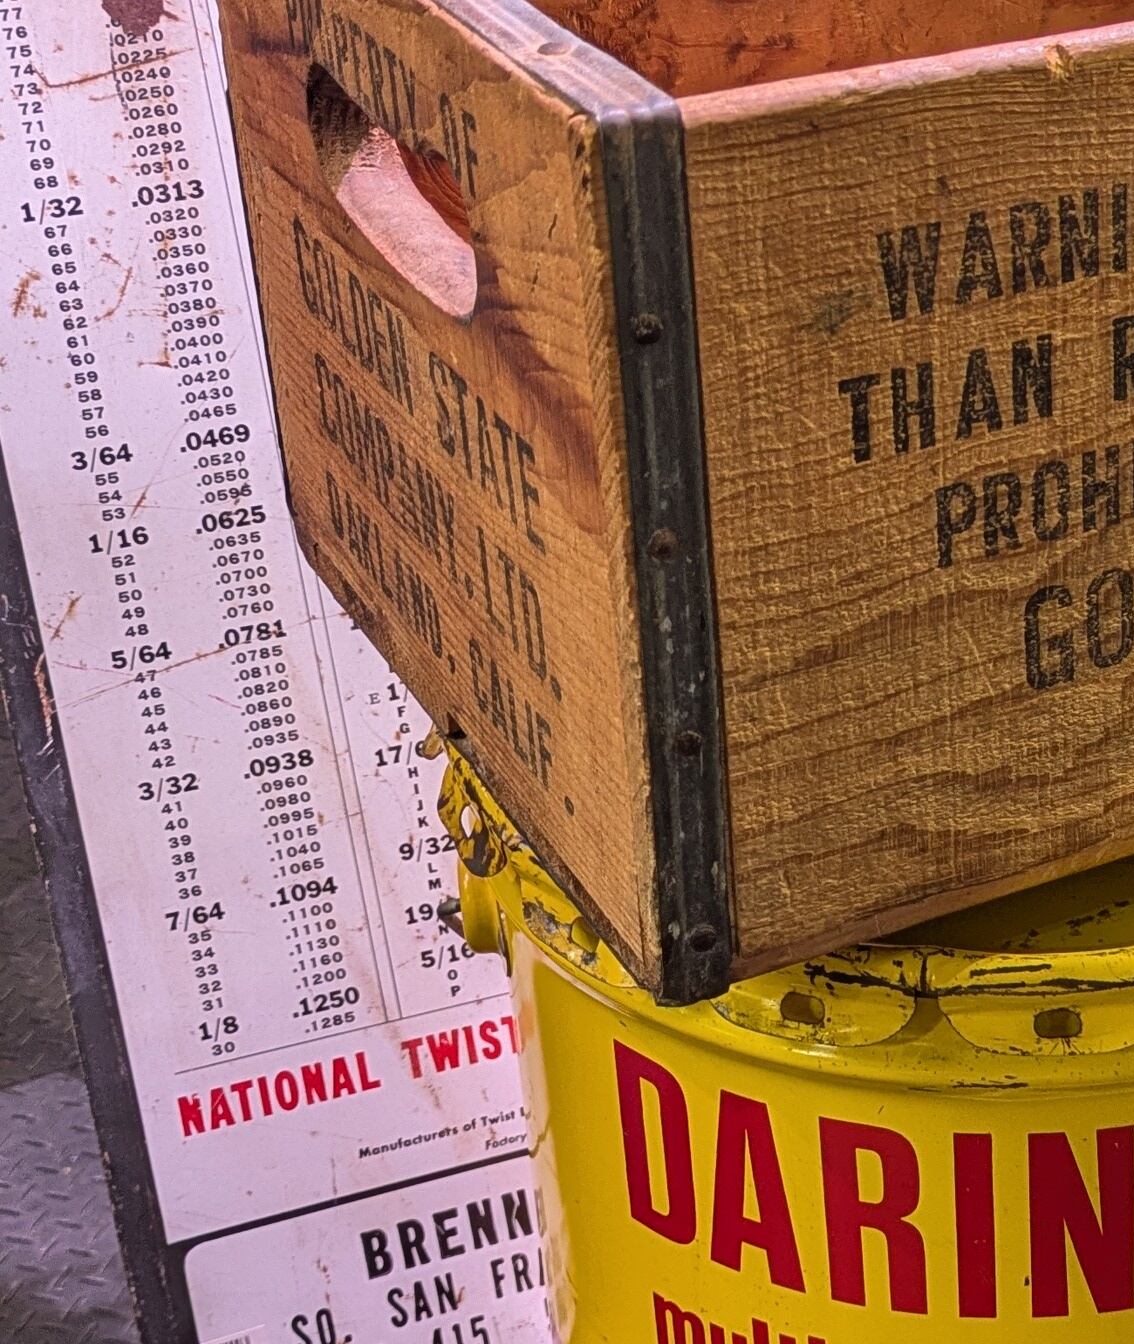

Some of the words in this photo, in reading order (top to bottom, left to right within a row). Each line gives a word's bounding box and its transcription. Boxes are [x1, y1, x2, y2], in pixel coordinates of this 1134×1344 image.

[2, 26, 27, 40] 76
[10, 64, 36, 78] 74
[18, 101, 43, 115] 72
[122, 85, 174, 102] .0250
[26, 139, 51, 152] 70
[128, 122, 181, 139] .0280
[439, 91, 478, 198] OF
[34, 175, 58, 189] 68
[136, 158, 189, 176] .0310
[21, 196, 83, 224] 1/32
[132, 180, 204, 206] .0313
[48, 243, 72, 257] 66
[149, 225, 202, 243] .0330
[56, 280, 80, 294] 64
[156, 261, 209, 279] .0360
[63, 317, 87, 330] 62
[71, 353, 95, 367] 60
[170, 333, 223, 351] .0400
[79, 389, 102, 403] 58
[177, 368, 230, 387] .0420
[294, 214, 414, 417] GOLDEN
[429, 351, 546, 555] STATE
[839, 333, 1054, 464] THAN
[85, 425, 109, 438] 56
[184, 403, 236, 422] .0465
[71, 444, 133, 472] 3/64
[180, 424, 251, 453] .0469
[99, 490, 122, 504] 54
[197, 468, 249, 486] .0550
[89, 526, 149, 554] 1/16
[196, 505, 266, 533] .0625
[112, 555, 135, 568] 52
[209, 531, 261, 550] .0635
[119, 589, 142, 603] 50
[215, 566, 267, 585] .0700
[125, 624, 149, 637] 48
[222, 600, 273, 619] .0760
[111, 642, 172, 670] 5/64
[218, 620, 287, 649] .0781
[138, 687, 161, 700] 46
[234, 663, 285, 681] .0810
[145, 722, 168, 734] 44
[241, 697, 292, 715] .0860
[397, 706, 406, 718] F
[399, 723, 411, 734] G
[152, 756, 175, 768] 42
[247, 730, 299, 749] .0935
[138, 773, 199, 801] 3/32
[244, 749, 314, 777] .0938
[408, 767, 419, 779] H
[165, 818, 188, 831] 40
[260, 792, 310, 811] .0980
[418, 816, 429, 828] K
[172, 852, 195, 865] 38
[267, 824, 317, 844] .1015
[399, 834, 456, 862] 9/32
[179, 885, 202, 899] 36
[274, 858, 324, 877] .1065
[428, 862, 438, 874] L
[428, 877, 442, 890] M
[165, 902, 225, 931] 7/64
[270, 877, 338, 906] .1094
[192, 947, 215, 961] 34
[286, 919, 336, 939] .1110
[199, 980, 222, 994] 32
[293, 952, 343, 971] .1160
[450, 984, 461, 997] P
[199, 1016, 239, 1041] 1/8
[292, 987, 359, 1017] .1250
[212, 1042, 235, 1056] 30
[305, 1012, 355, 1032] .1285
[176, 1051, 381, 1137] NATIONAL
[401, 1015, 520, 1080] TWIST
[463, 1119, 478, 1132] of
[480, 1111, 516, 1128] Twist
[485, 1133, 528, 1151] Factory
[386, 1271, 459, 1328] SAN
